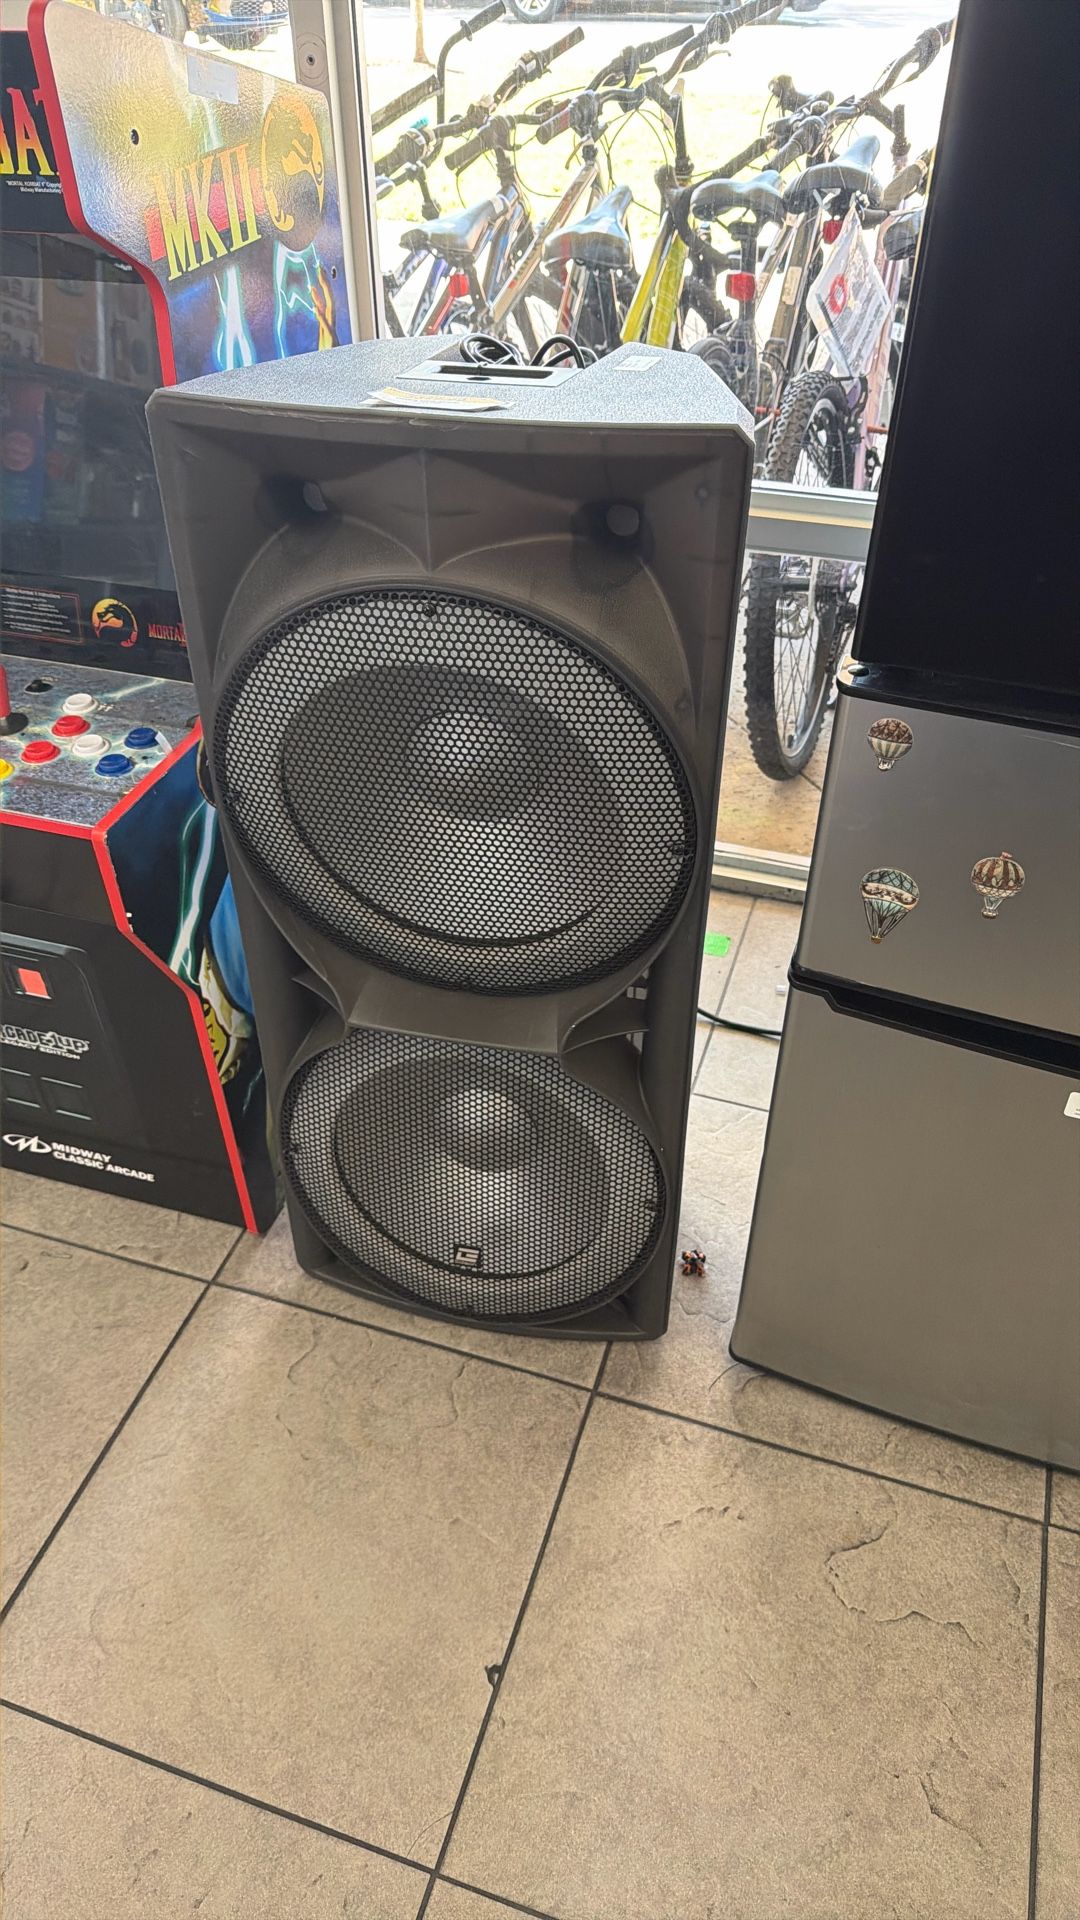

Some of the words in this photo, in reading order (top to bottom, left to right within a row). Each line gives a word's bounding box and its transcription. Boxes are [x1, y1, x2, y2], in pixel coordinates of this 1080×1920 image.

[151, 143, 262, 281] MKII
[0, 1023, 89, 1054] CADE1UP
[51, 1142, 112, 1163] MIDWAY
[53, 1151, 104, 1170] CLASSIC
[105, 1163, 155, 1182] ARCADE
